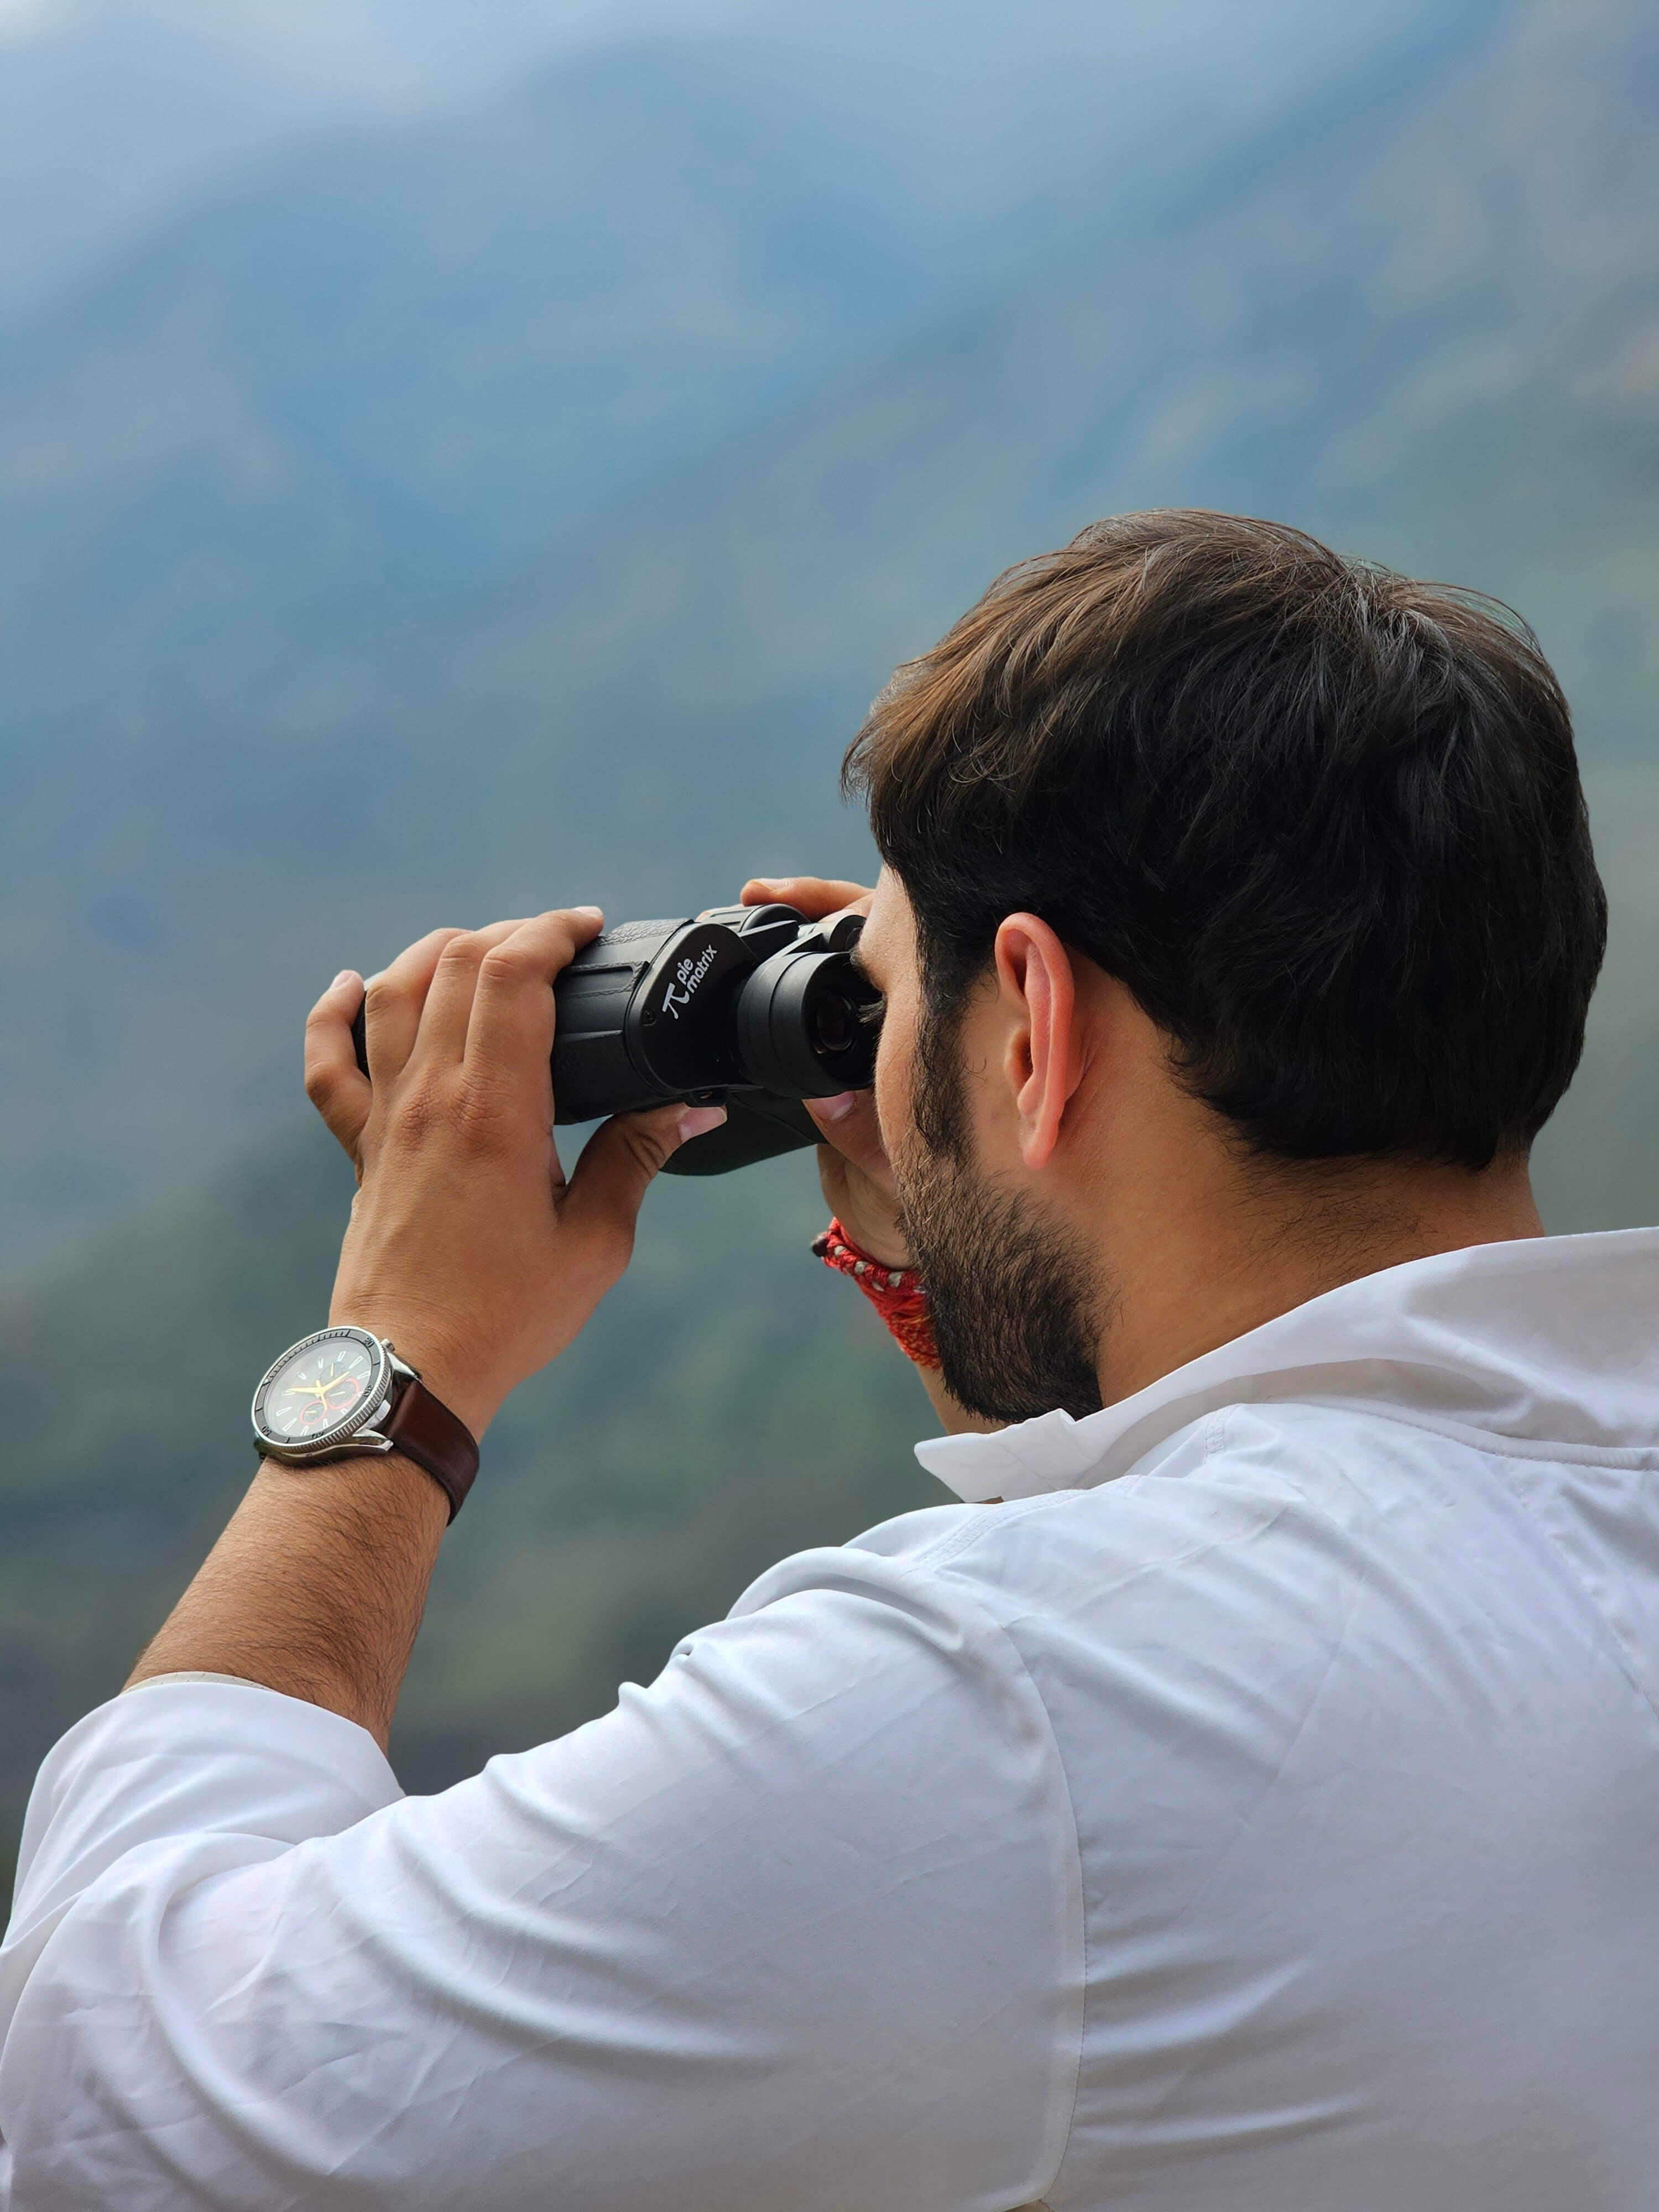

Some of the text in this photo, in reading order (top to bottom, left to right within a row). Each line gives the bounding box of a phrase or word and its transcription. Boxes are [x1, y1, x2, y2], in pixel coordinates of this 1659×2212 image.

[677, 958, 693, 985] pie
[687, 944, 717, 994] matrix
[364, 1337, 374, 1348] 20
